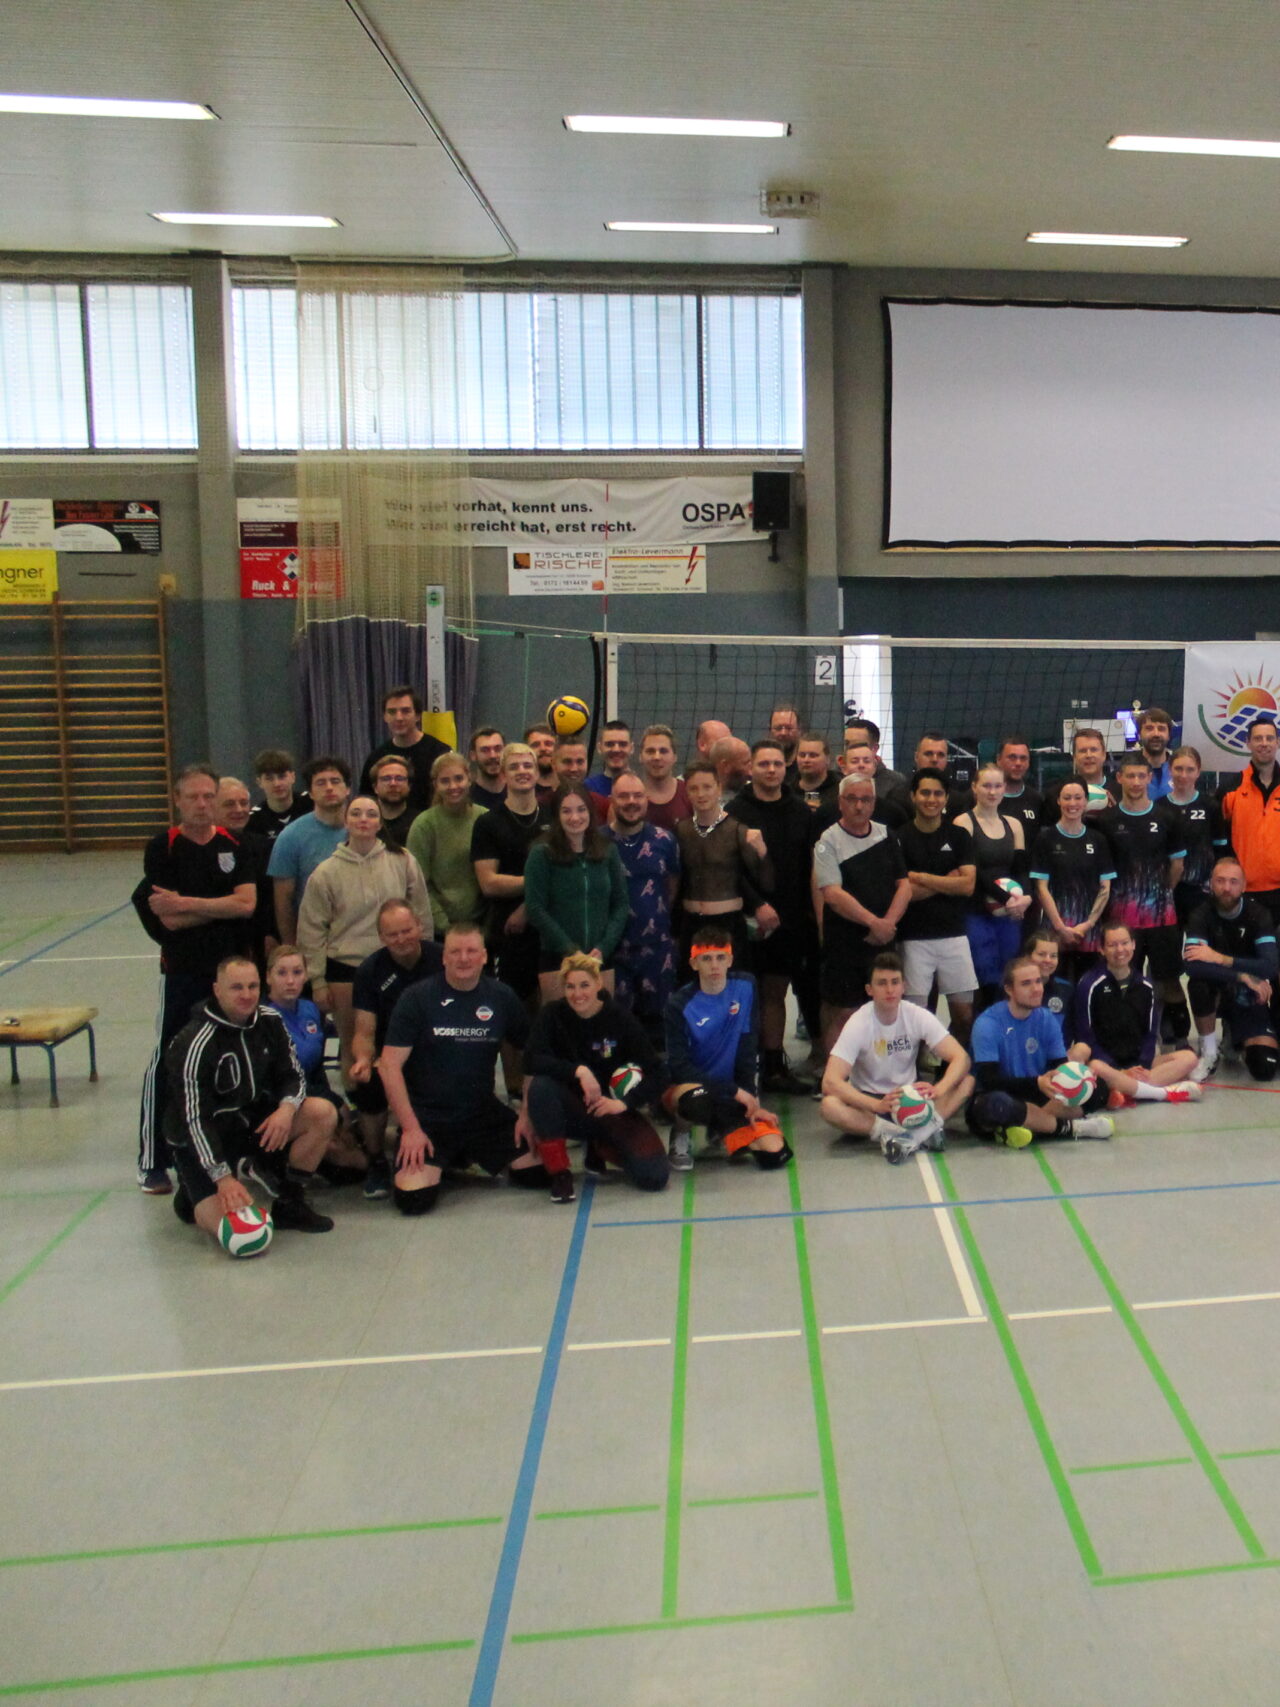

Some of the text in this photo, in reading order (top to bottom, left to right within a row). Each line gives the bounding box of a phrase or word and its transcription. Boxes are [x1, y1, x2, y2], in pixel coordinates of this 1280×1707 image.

[512, 501, 556, 513] kennt
[561, 503, 593, 513] uns.
[682, 503, 745, 522] OSPA
[521, 520, 550, 535] hat,
[556, 520, 585, 532] erst
[591, 520, 636, 533] recht.
[535, 560, 603, 569] RISCHE
[819, 660, 832, 680] 2
[1023, 809, 1035, 819] 10
[1190, 810, 1206, 820] 22
[1150, 822, 1158, 832] 2
[1086, 844, 1094, 854] 5
[433, 1027, 488, 1036] VOSSENERGY
